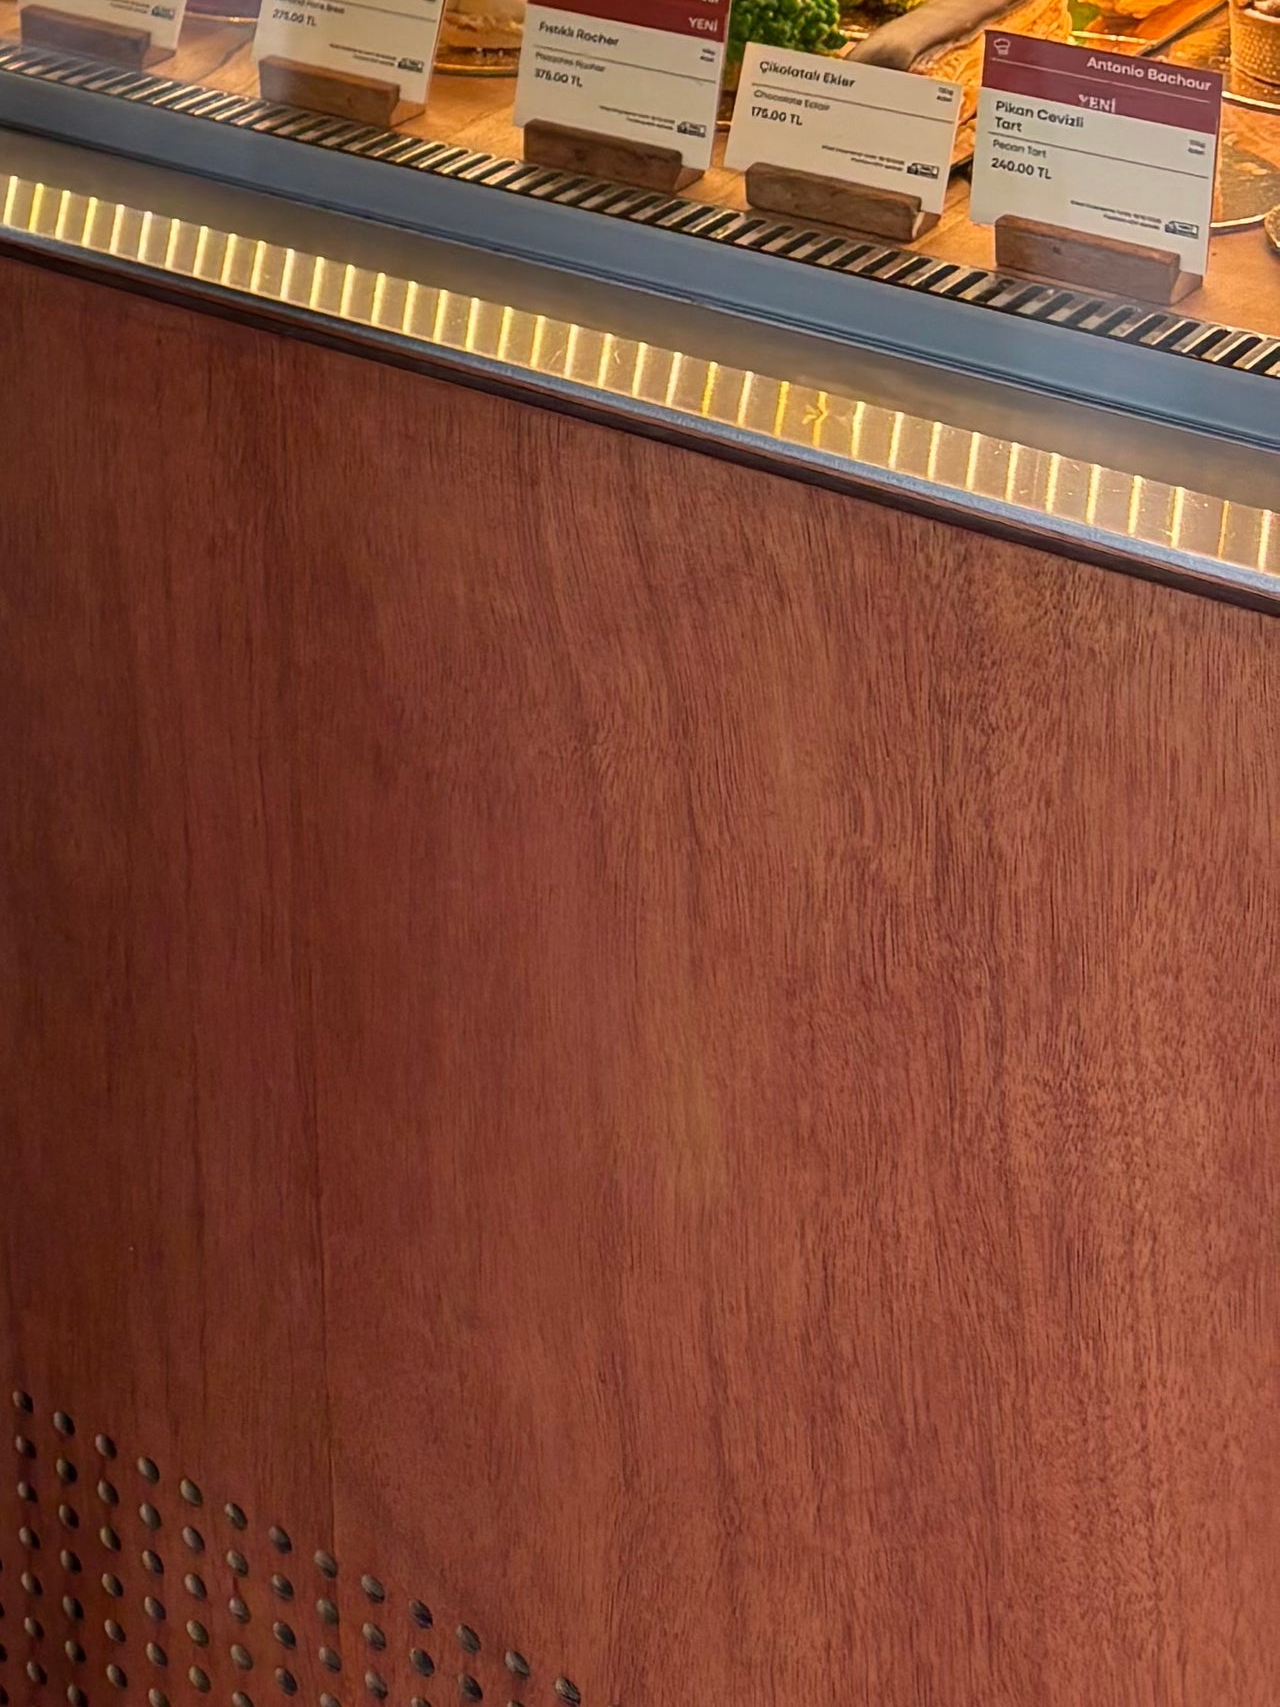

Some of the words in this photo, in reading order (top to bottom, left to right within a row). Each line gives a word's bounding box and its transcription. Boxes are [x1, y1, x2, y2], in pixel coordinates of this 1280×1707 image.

[307, 17, 316, 27] TL
[689, 16, 718, 32] YENİ
[576, 29, 619, 46] Rocher
[570, 76, 583, 88] TL
[759, 61, 820, 82] Çikolatalı
[823, 72, 856, 88] Ekler
[1087, 57, 1145, 78] Antonio
[1147, 68, 1212, 92] Bachour
[754, 90, 802, 107] Chocolate
[1078, 93, 1116, 113] YENİ
[751, 107, 786, 123] 175.00
[790, 114, 803, 126] TL
[995, 100, 1035, 119] Pikan
[1037, 109, 1084, 128] Cevizli
[995, 117, 1022, 133] Tart
[993, 139, 1025, 155] Pecan
[1027, 147, 1047, 159] Tart
[991, 157, 1035, 176] 240.00
[1038, 166, 1052, 180] TL
